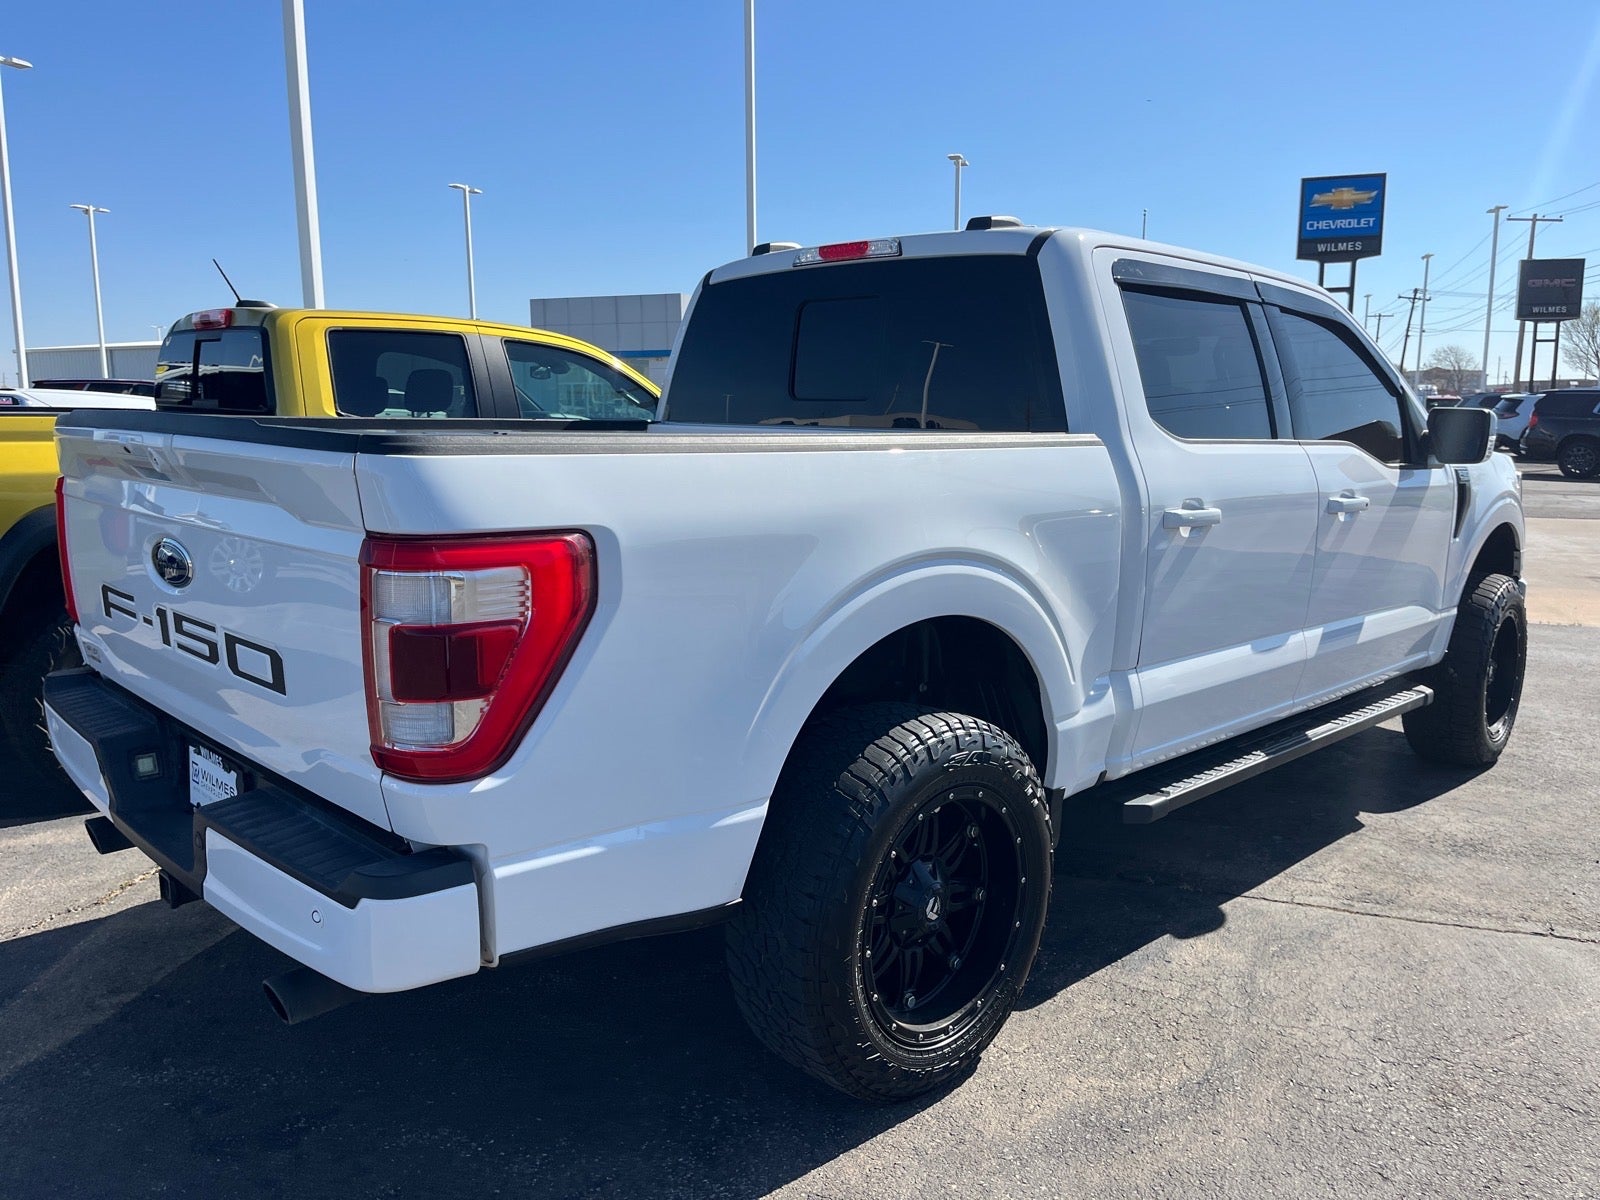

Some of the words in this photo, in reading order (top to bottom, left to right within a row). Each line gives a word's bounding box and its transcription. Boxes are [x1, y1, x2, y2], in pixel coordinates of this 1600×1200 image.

[1306, 217, 1376, 231] CHEVROLET
[1317, 241, 1362, 252] WILMES
[1527, 278, 1577, 288] GMC
[1532, 305, 1567, 314] WILMES
[101, 583, 287, 696] F-150
[201, 768, 236, 798] WILMES
